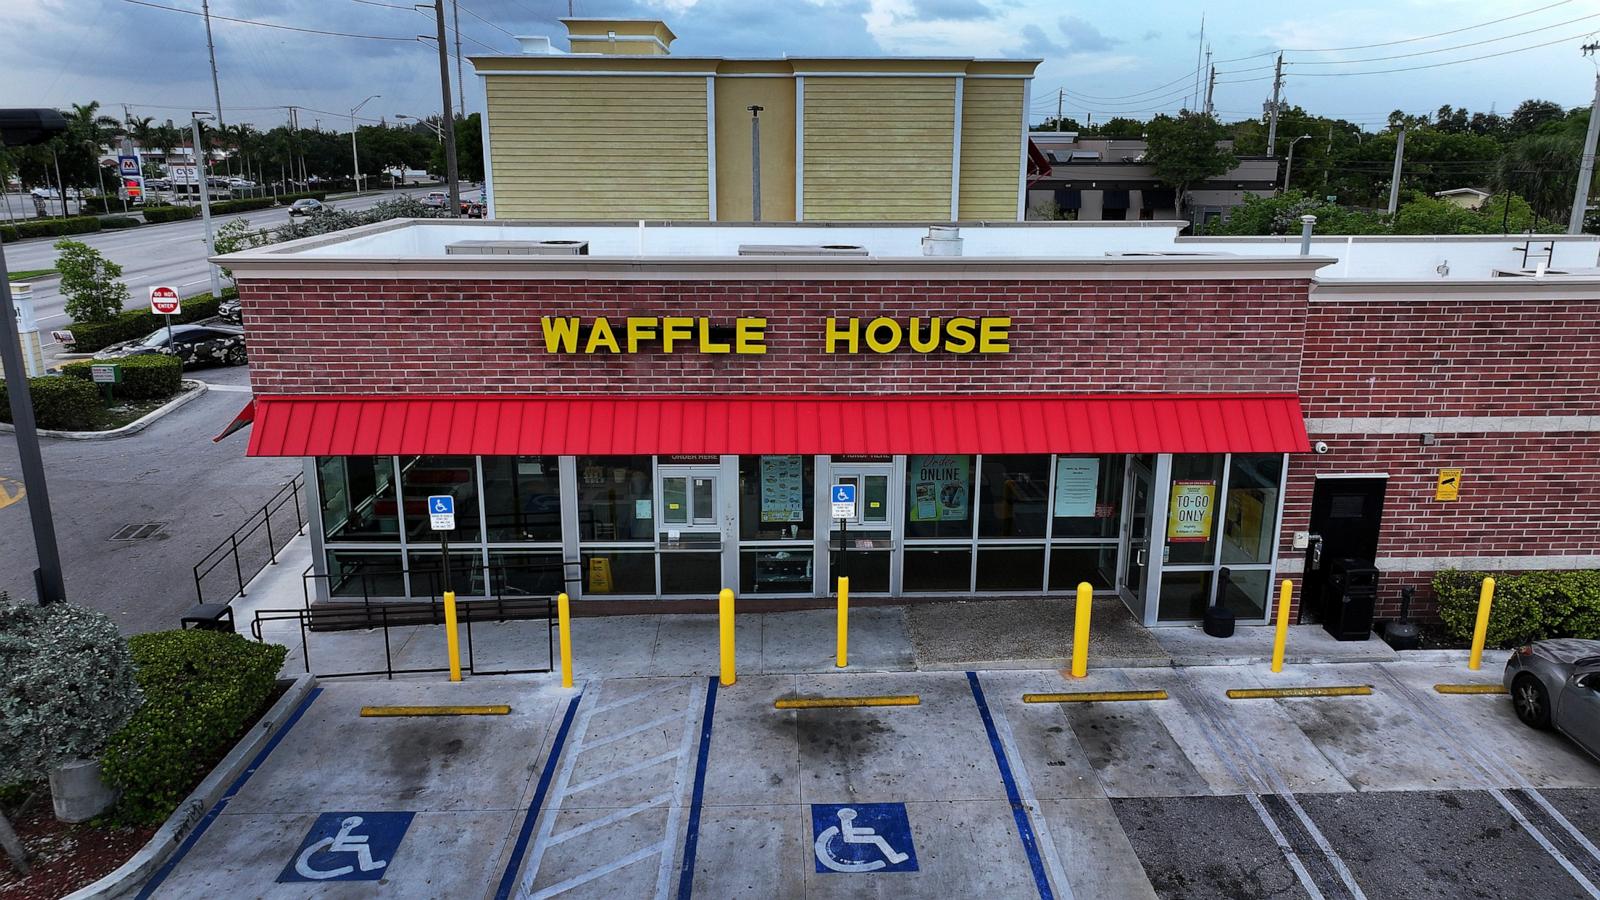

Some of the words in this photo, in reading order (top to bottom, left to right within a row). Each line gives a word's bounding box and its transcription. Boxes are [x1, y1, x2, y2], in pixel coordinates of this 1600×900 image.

[541, 317, 767, 353] WAFFLE
[825, 317, 1011, 353] HOUSE
[920, 468, 960, 481] ONLINE
[1177, 495, 1209, 508] TO-GO
[1178, 509, 1205, 522] ONLY
